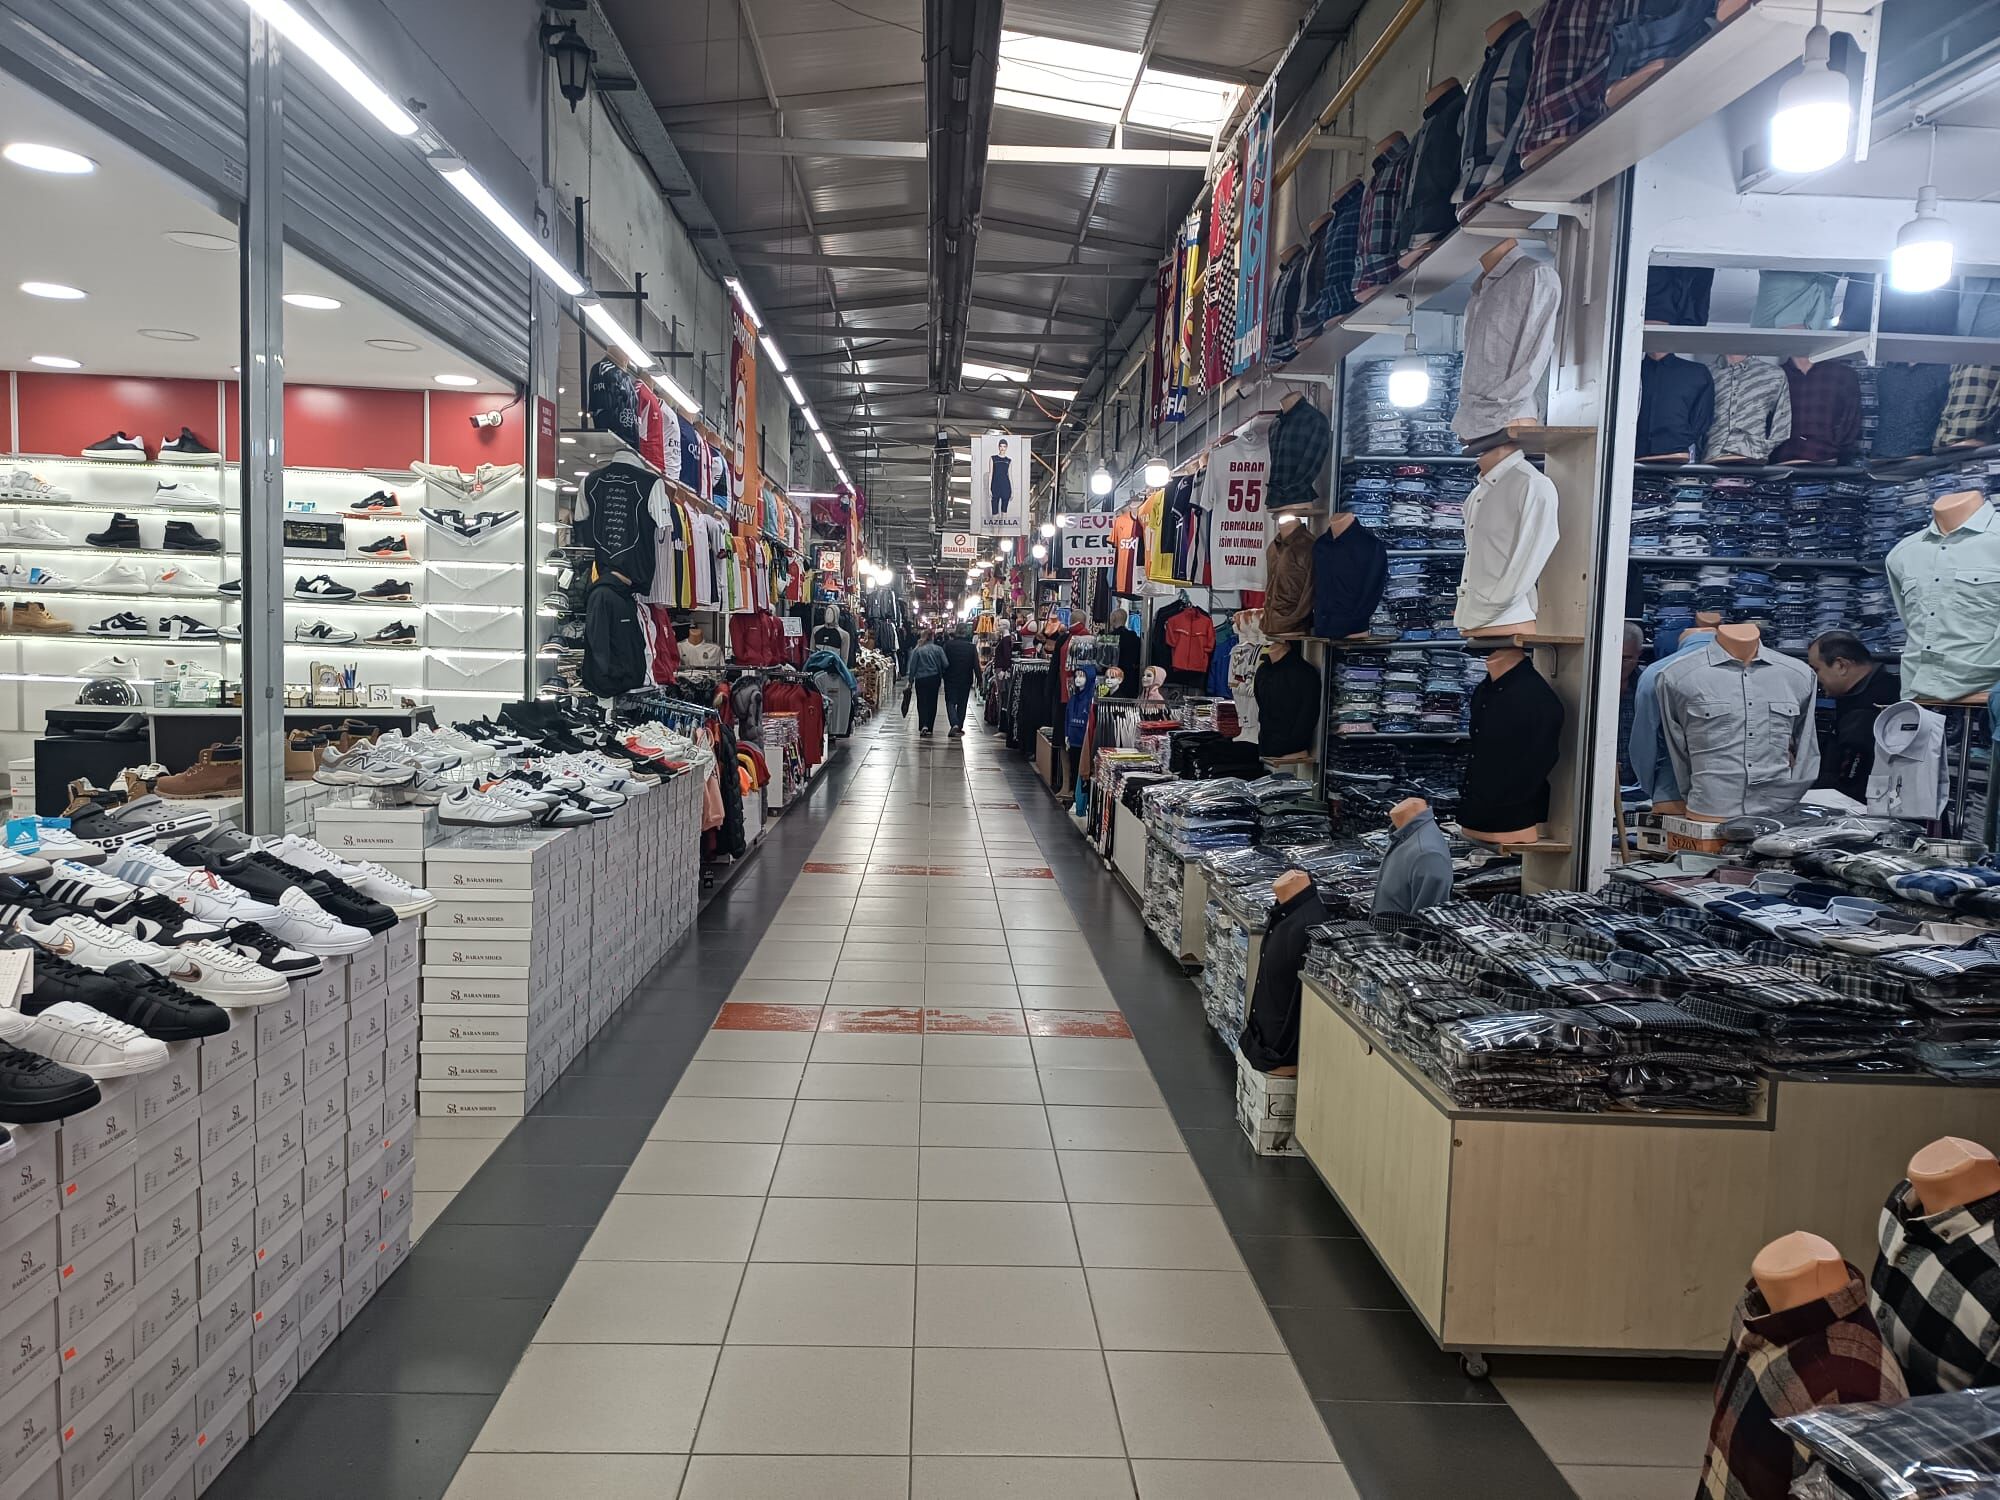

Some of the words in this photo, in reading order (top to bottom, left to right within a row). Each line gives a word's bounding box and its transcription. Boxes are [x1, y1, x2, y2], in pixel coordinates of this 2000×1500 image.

[1229, 461, 1265, 473] BARAN
[1227, 479, 1262, 513] 55
[1068, 556, 1093, 566] 0543
[1096, 556, 1114, 566] 718
[1224, 554, 1257, 567] YAZILIR
[1671, 835, 1698, 851] SEZON
